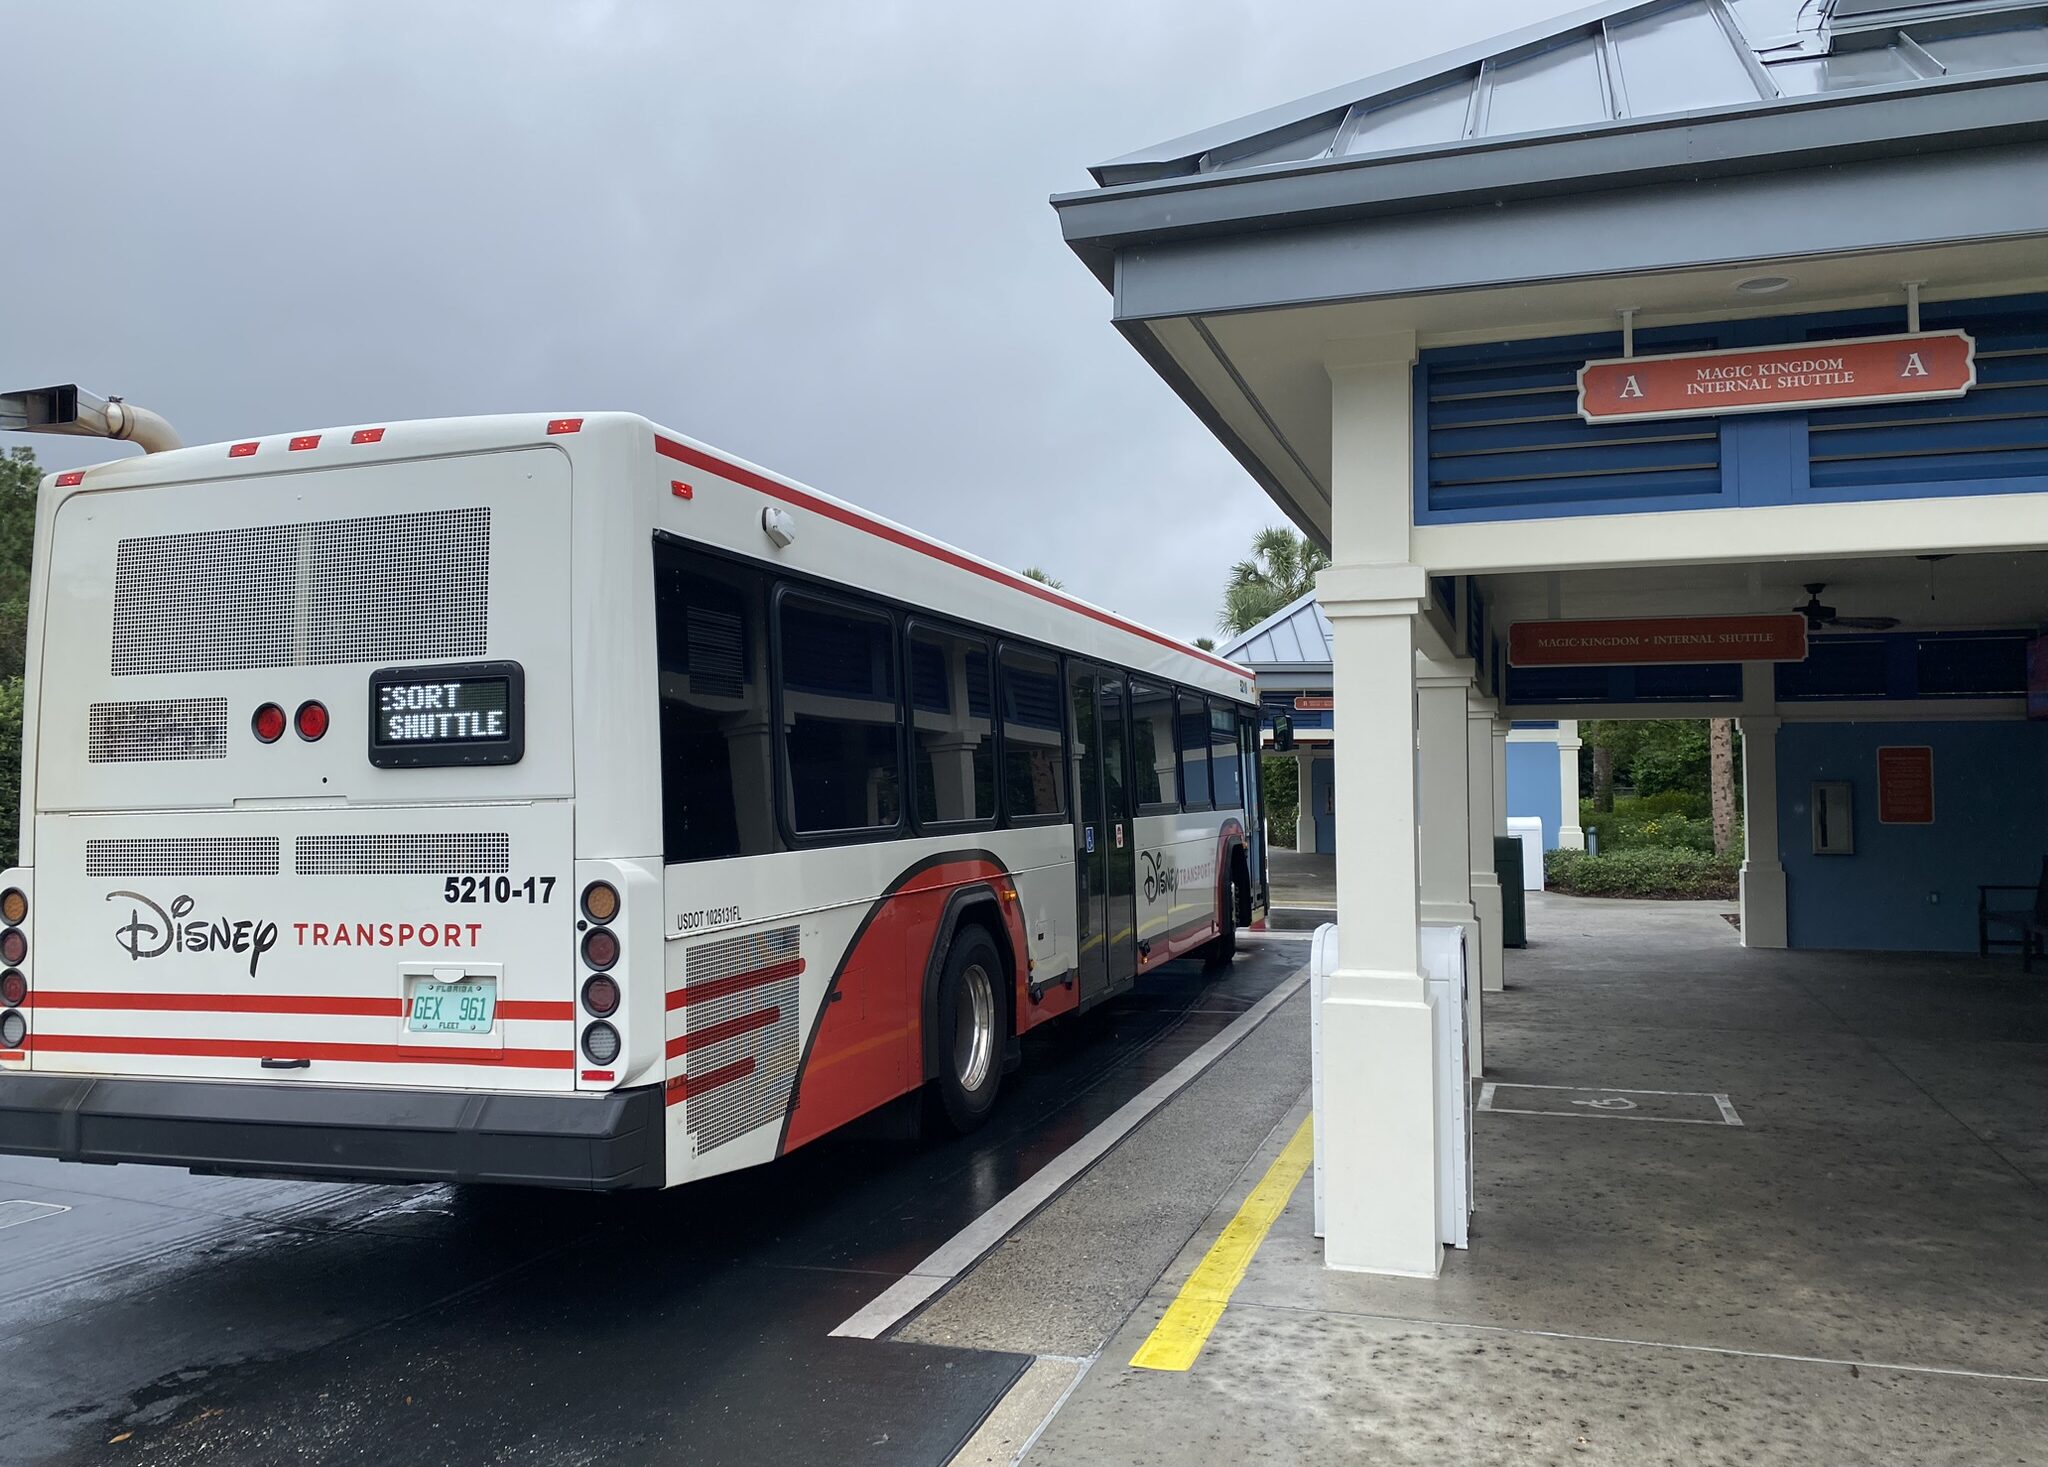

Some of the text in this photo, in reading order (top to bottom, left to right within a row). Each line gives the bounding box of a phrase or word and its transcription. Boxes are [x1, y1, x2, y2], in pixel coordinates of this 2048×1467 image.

[1696, 357, 1844, 381] MAGIC KINGDOM
[1900, 352, 1928, 378] A
[1619, 375, 1644, 399] A
[1686, 371, 1855, 395] INTERNAL SHUTTLE
[1653, 633, 1715, 646] INTERNAL
[1719, 632, 1774, 644] SHUTTLE
[389, 711, 503, 740] SHUTTLE
[1180, 862, 1211, 886] TRANSPORT
[444, 876, 556, 905] 5210-17
[677, 906, 742, 930] USDOT 1025131FL
[293, 922, 483, 948] TRANSPORT
[435, 985, 474, 993] FLORIDA
[413, 996, 486, 1021] GEX 961
[438, 1022, 459, 1030] FLEET
